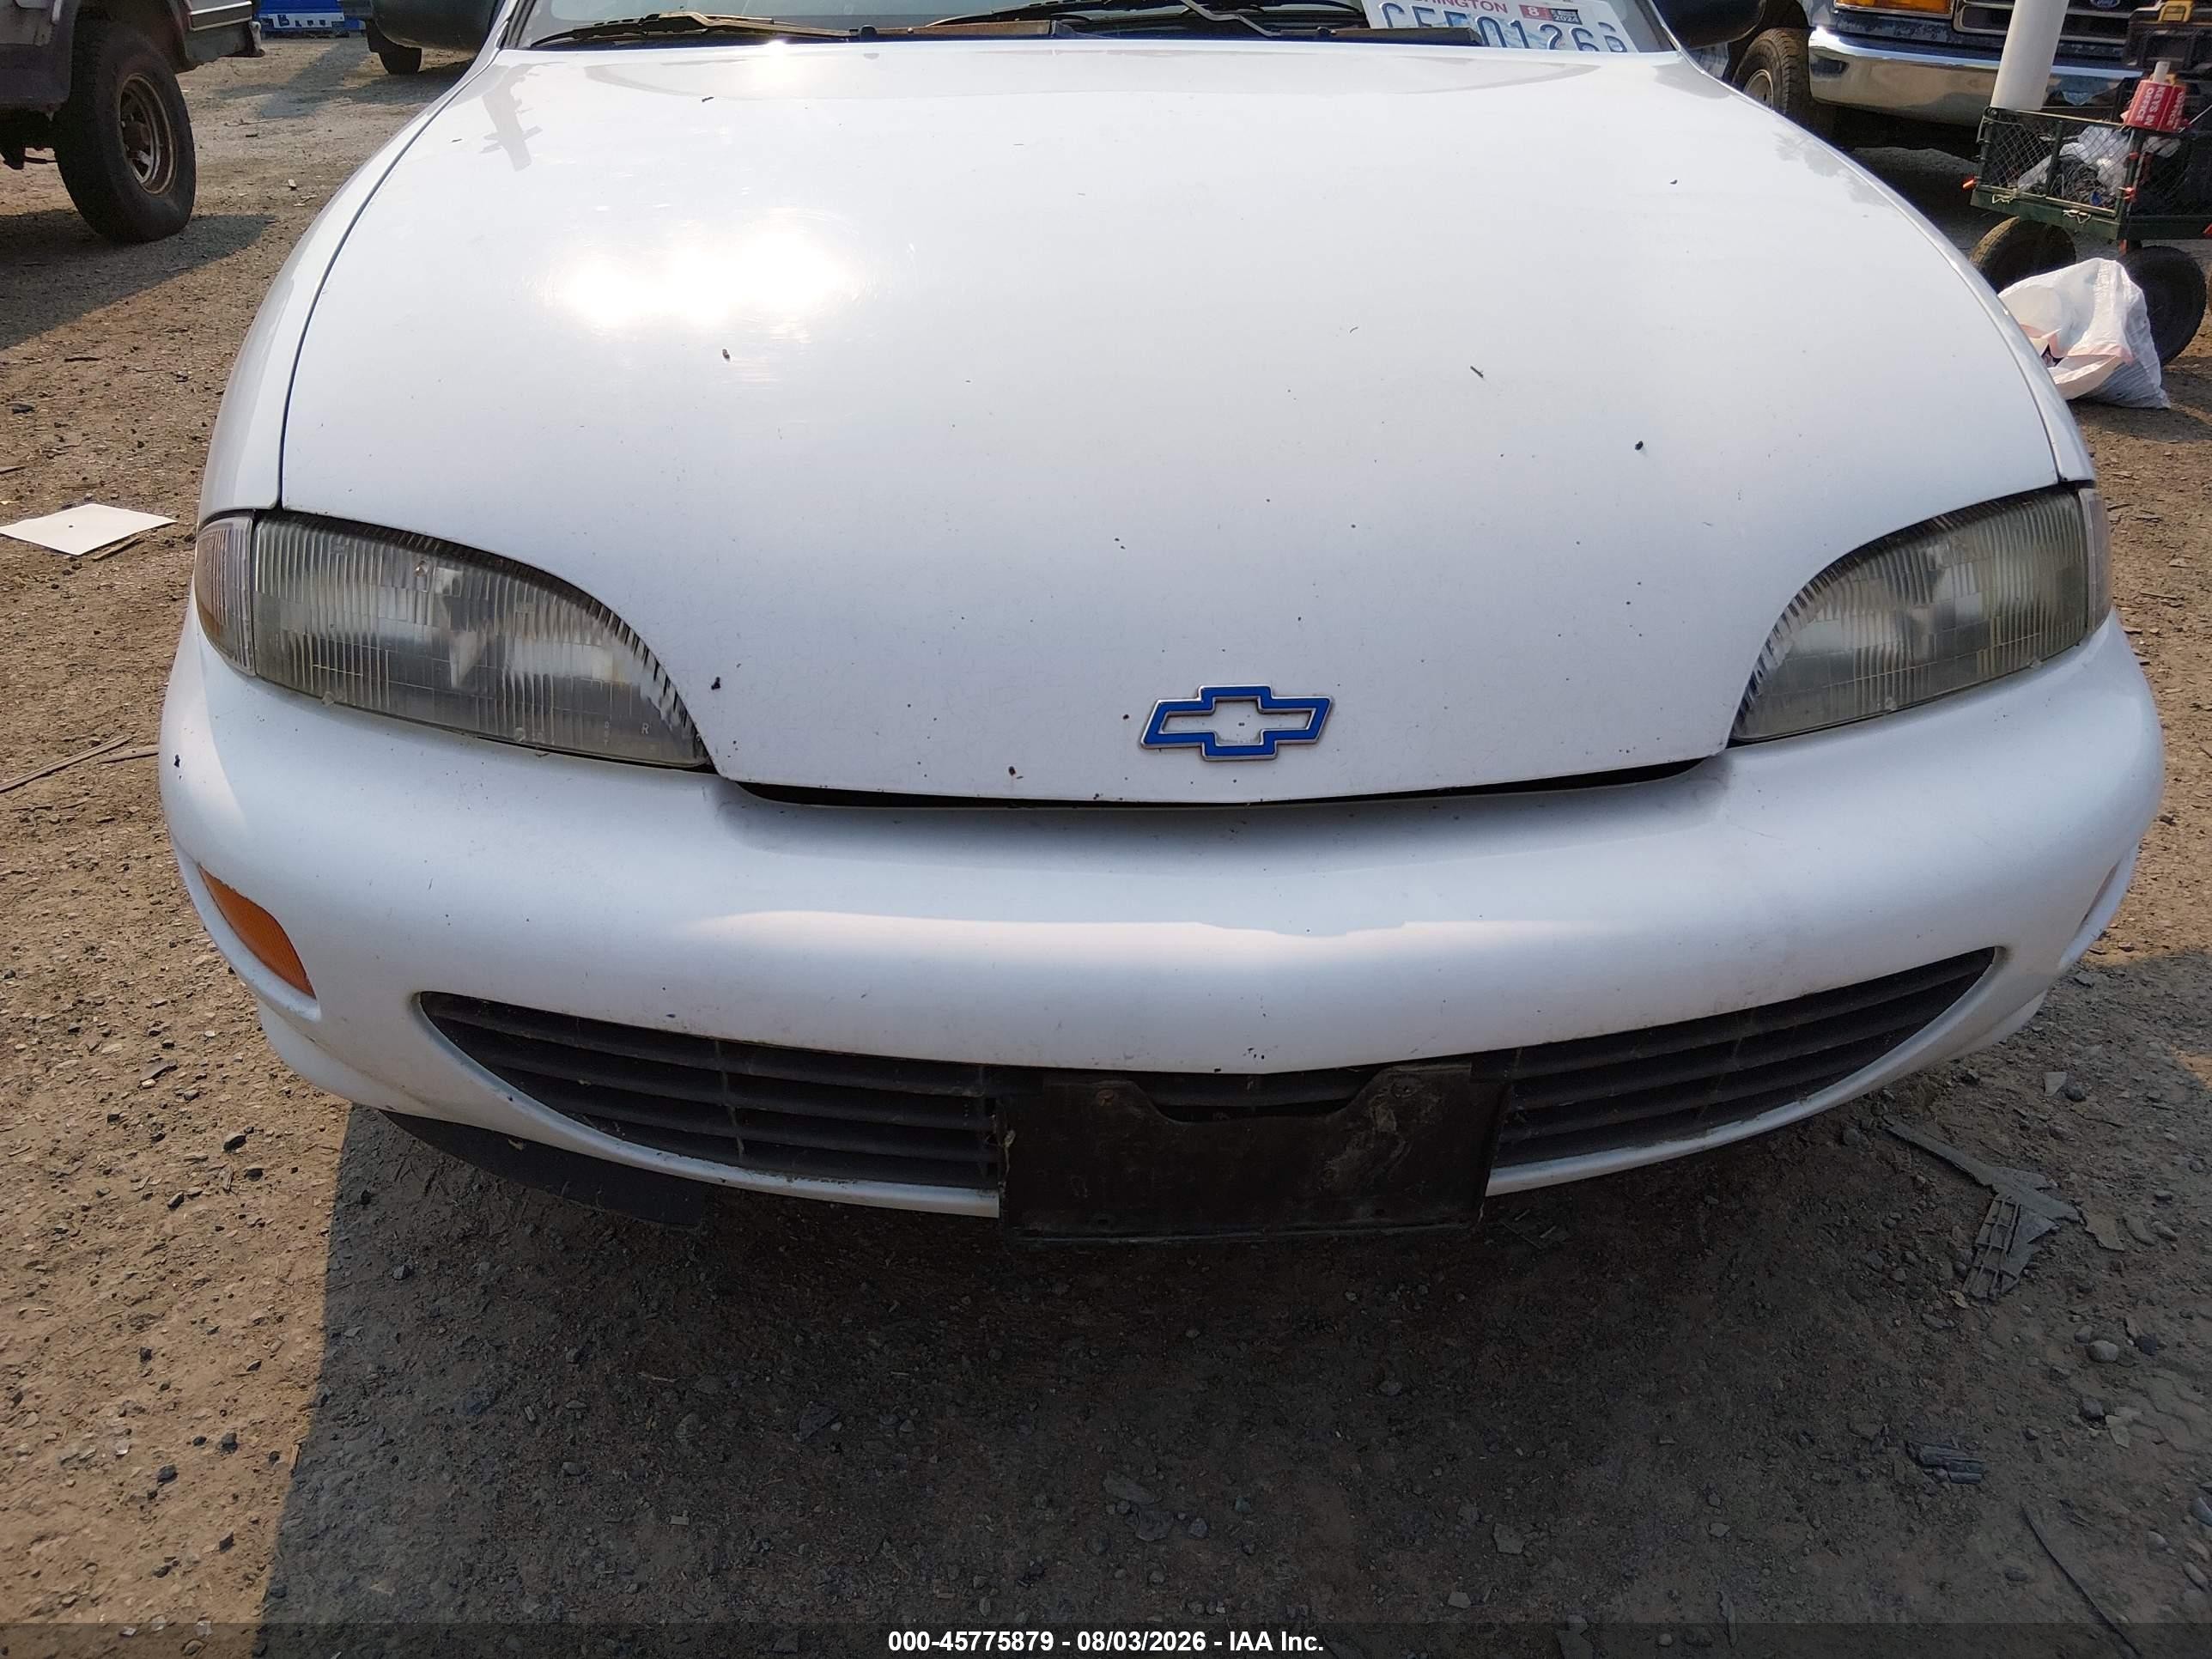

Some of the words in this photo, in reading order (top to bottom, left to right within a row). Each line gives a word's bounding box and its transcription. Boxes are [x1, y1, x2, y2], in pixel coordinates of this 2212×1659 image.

[1528, 7, 1539, 16] 8
[2136, 88, 2154, 121] OFFICE
[2149, 86, 2166, 112] KEYS
